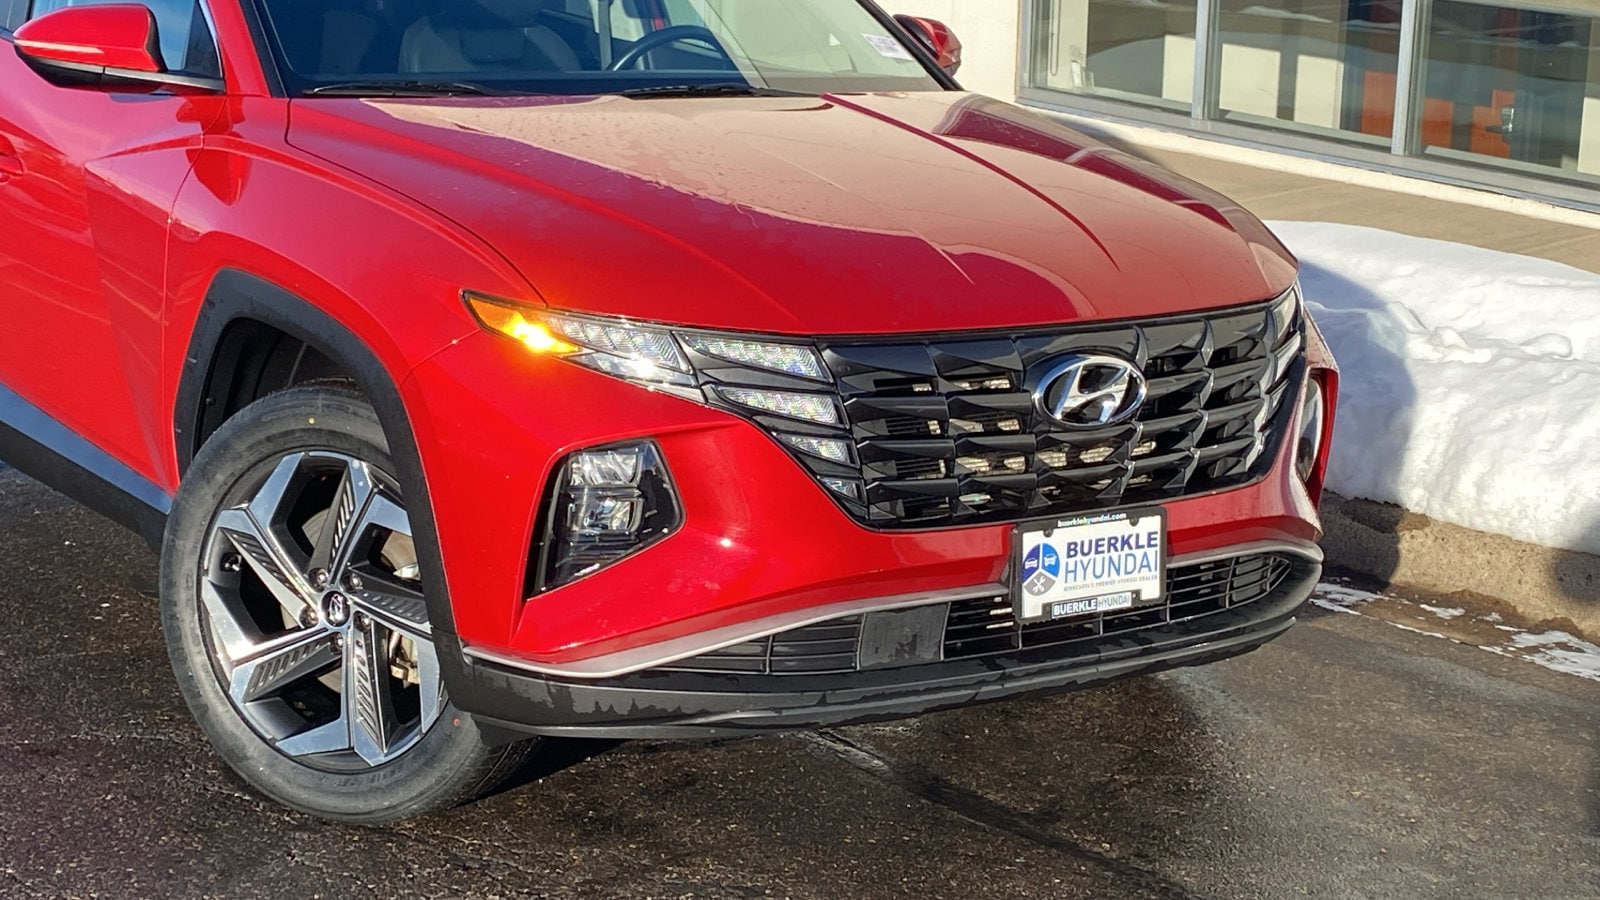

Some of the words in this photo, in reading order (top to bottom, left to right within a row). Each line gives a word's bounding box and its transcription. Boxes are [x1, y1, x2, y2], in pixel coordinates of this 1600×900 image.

[1066, 531, 1158, 559] BUERKLE
[1065, 550, 1158, 583] HYUNDAI
[1054, 599, 1097, 616] BUERKLE
[1098, 595, 1130, 607] HYUNDAI
